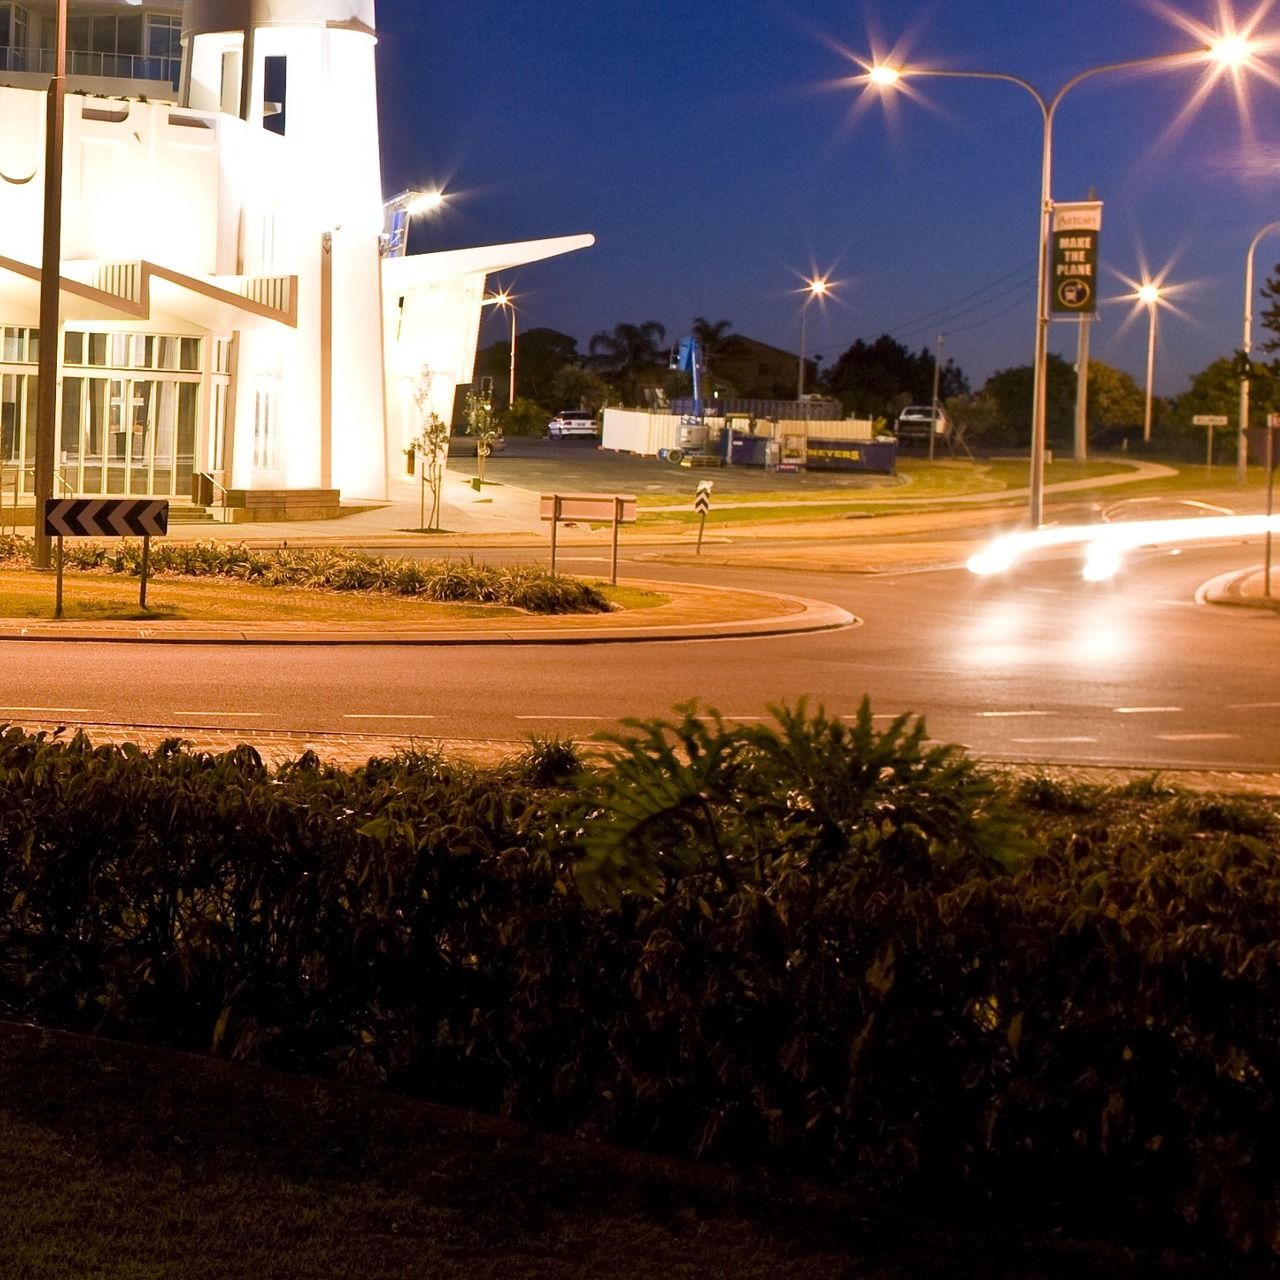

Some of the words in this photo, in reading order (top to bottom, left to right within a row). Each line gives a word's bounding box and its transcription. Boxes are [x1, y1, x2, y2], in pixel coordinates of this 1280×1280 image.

[1059, 237, 1091, 249] MAKE
[1064, 251, 1085, 262] THE
[1056, 264, 1092, 275] PLANE
